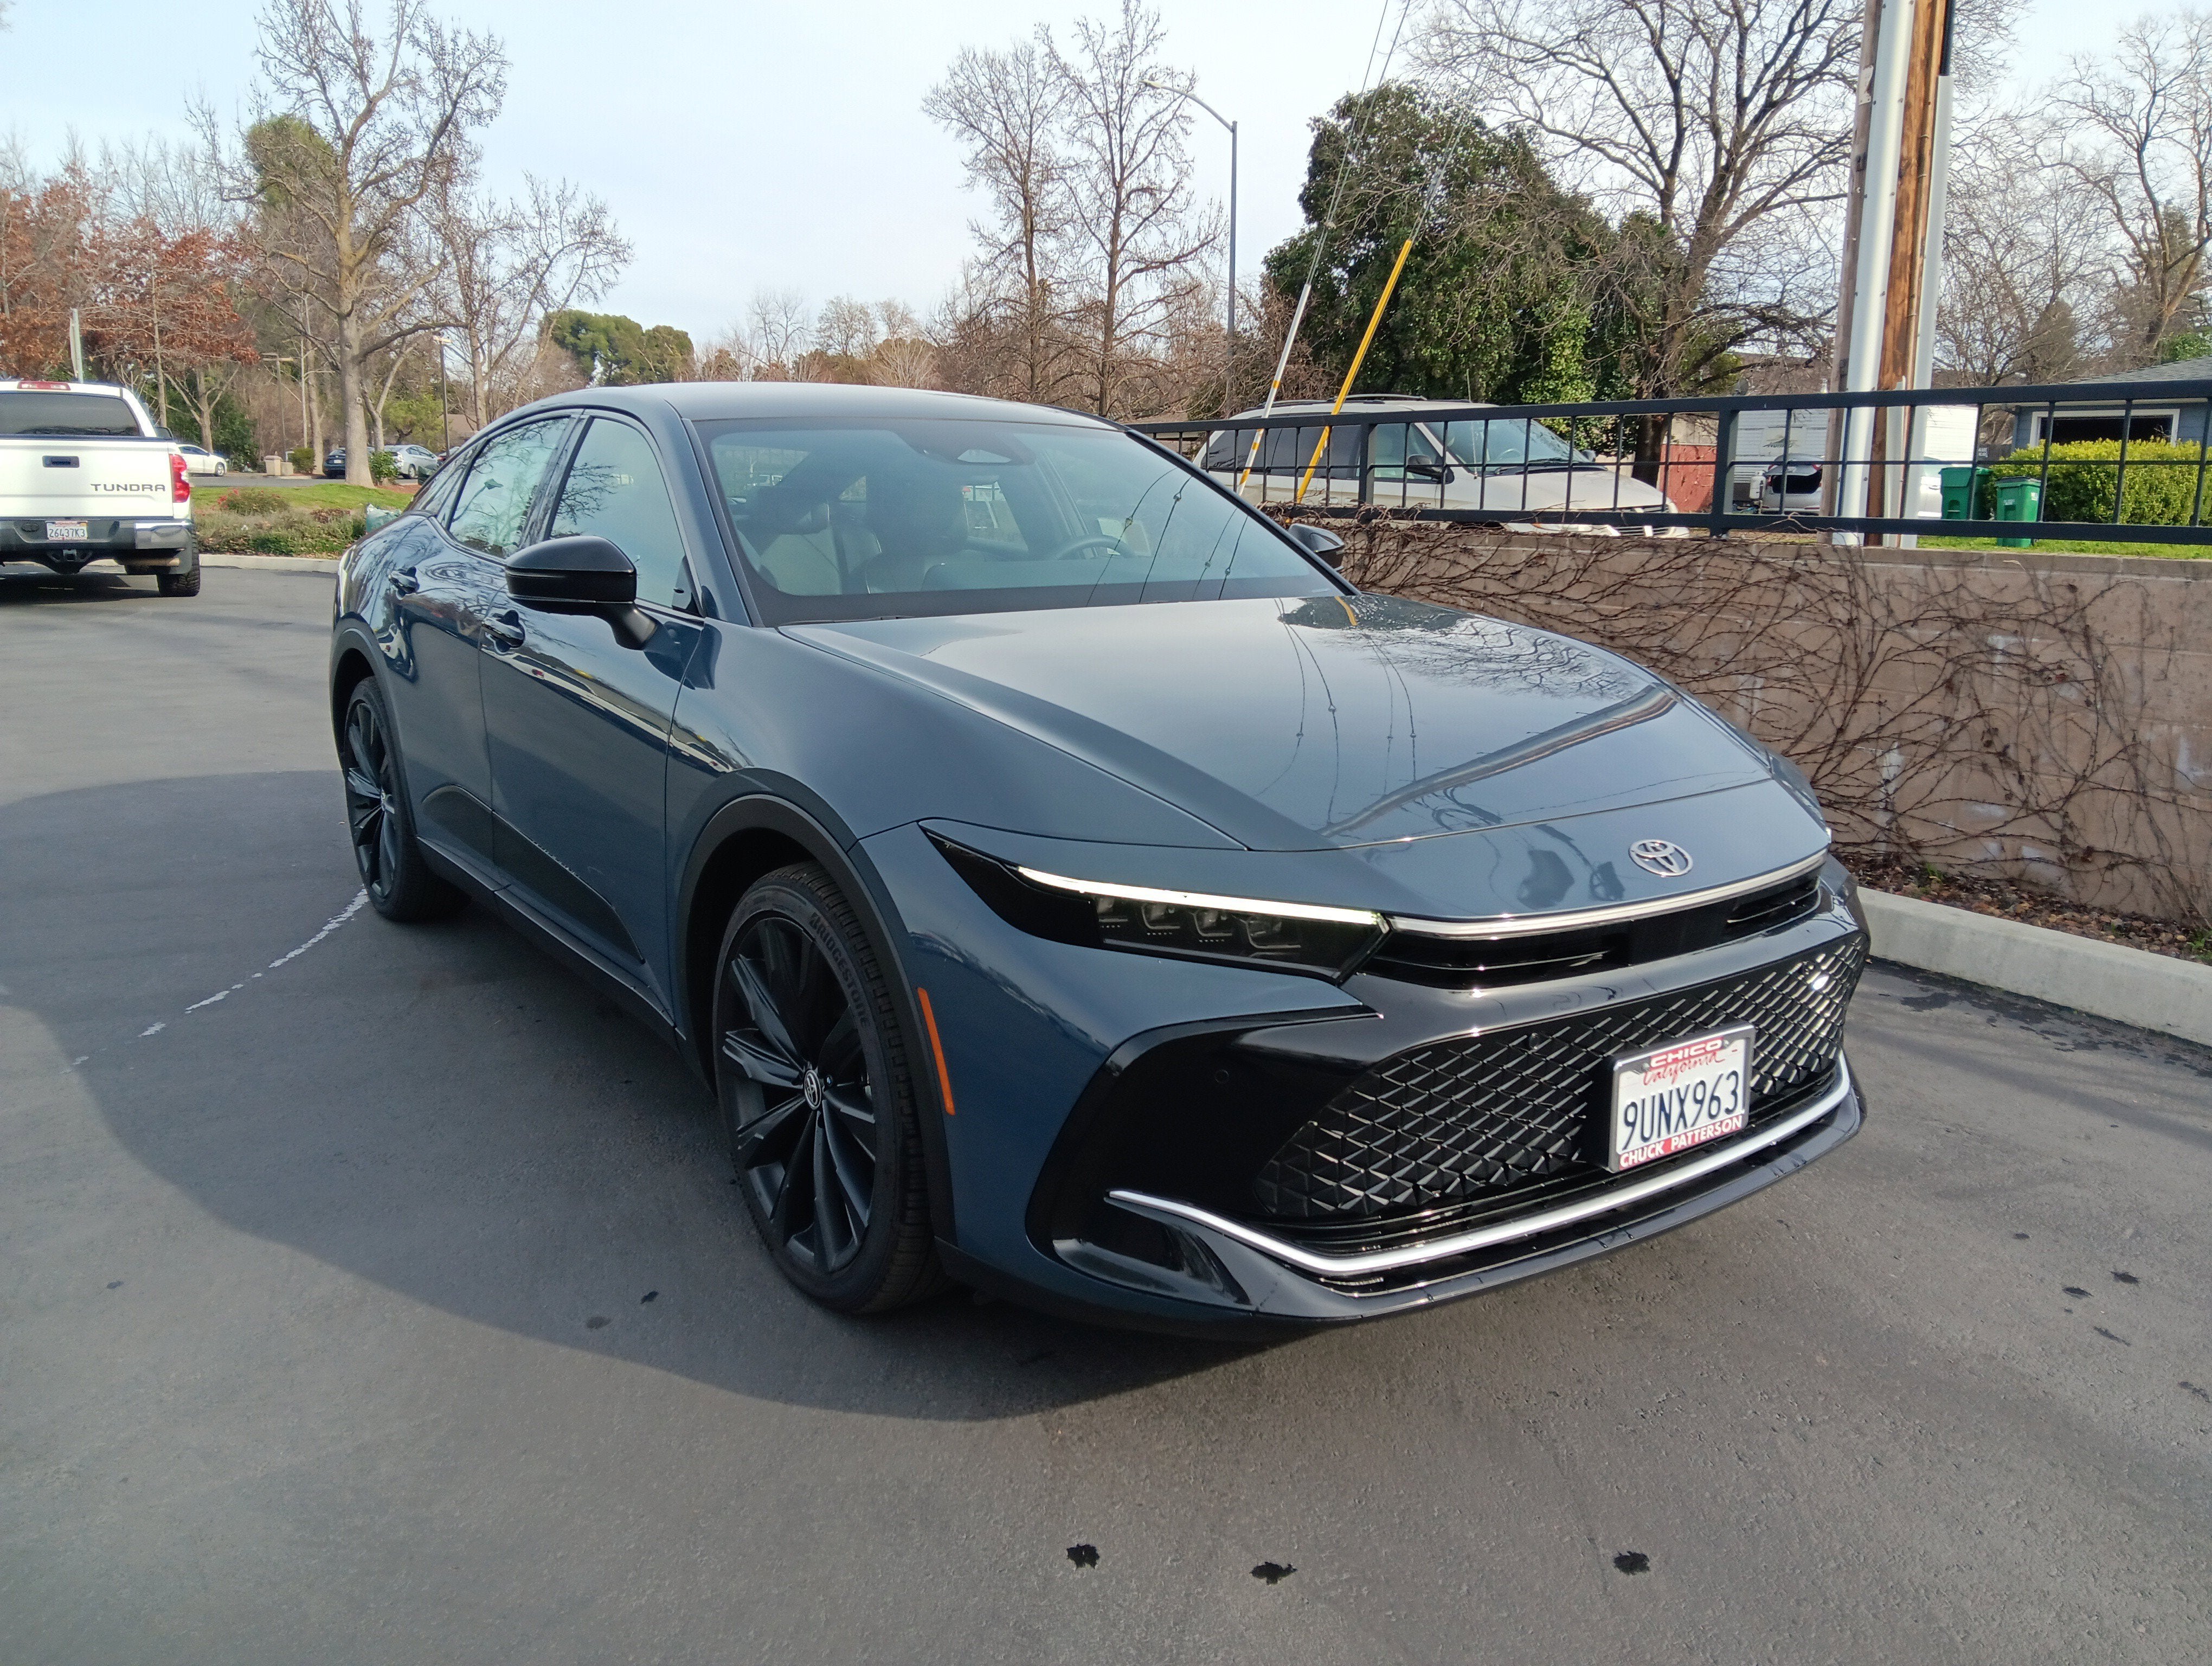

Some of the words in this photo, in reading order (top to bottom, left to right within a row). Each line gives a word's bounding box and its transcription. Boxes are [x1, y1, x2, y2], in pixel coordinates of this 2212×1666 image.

[49, 528, 85, 537] 26437K3
[809, 912, 870, 1028] BRIDGESTONE
[1650, 1039, 1722, 1067] CHICO
[1623, 1070, 1739, 1150] 9UNX963
[1619, 1143, 1665, 1168] CHUCK
[1671, 1116, 1742, 1151] PATTERSON
